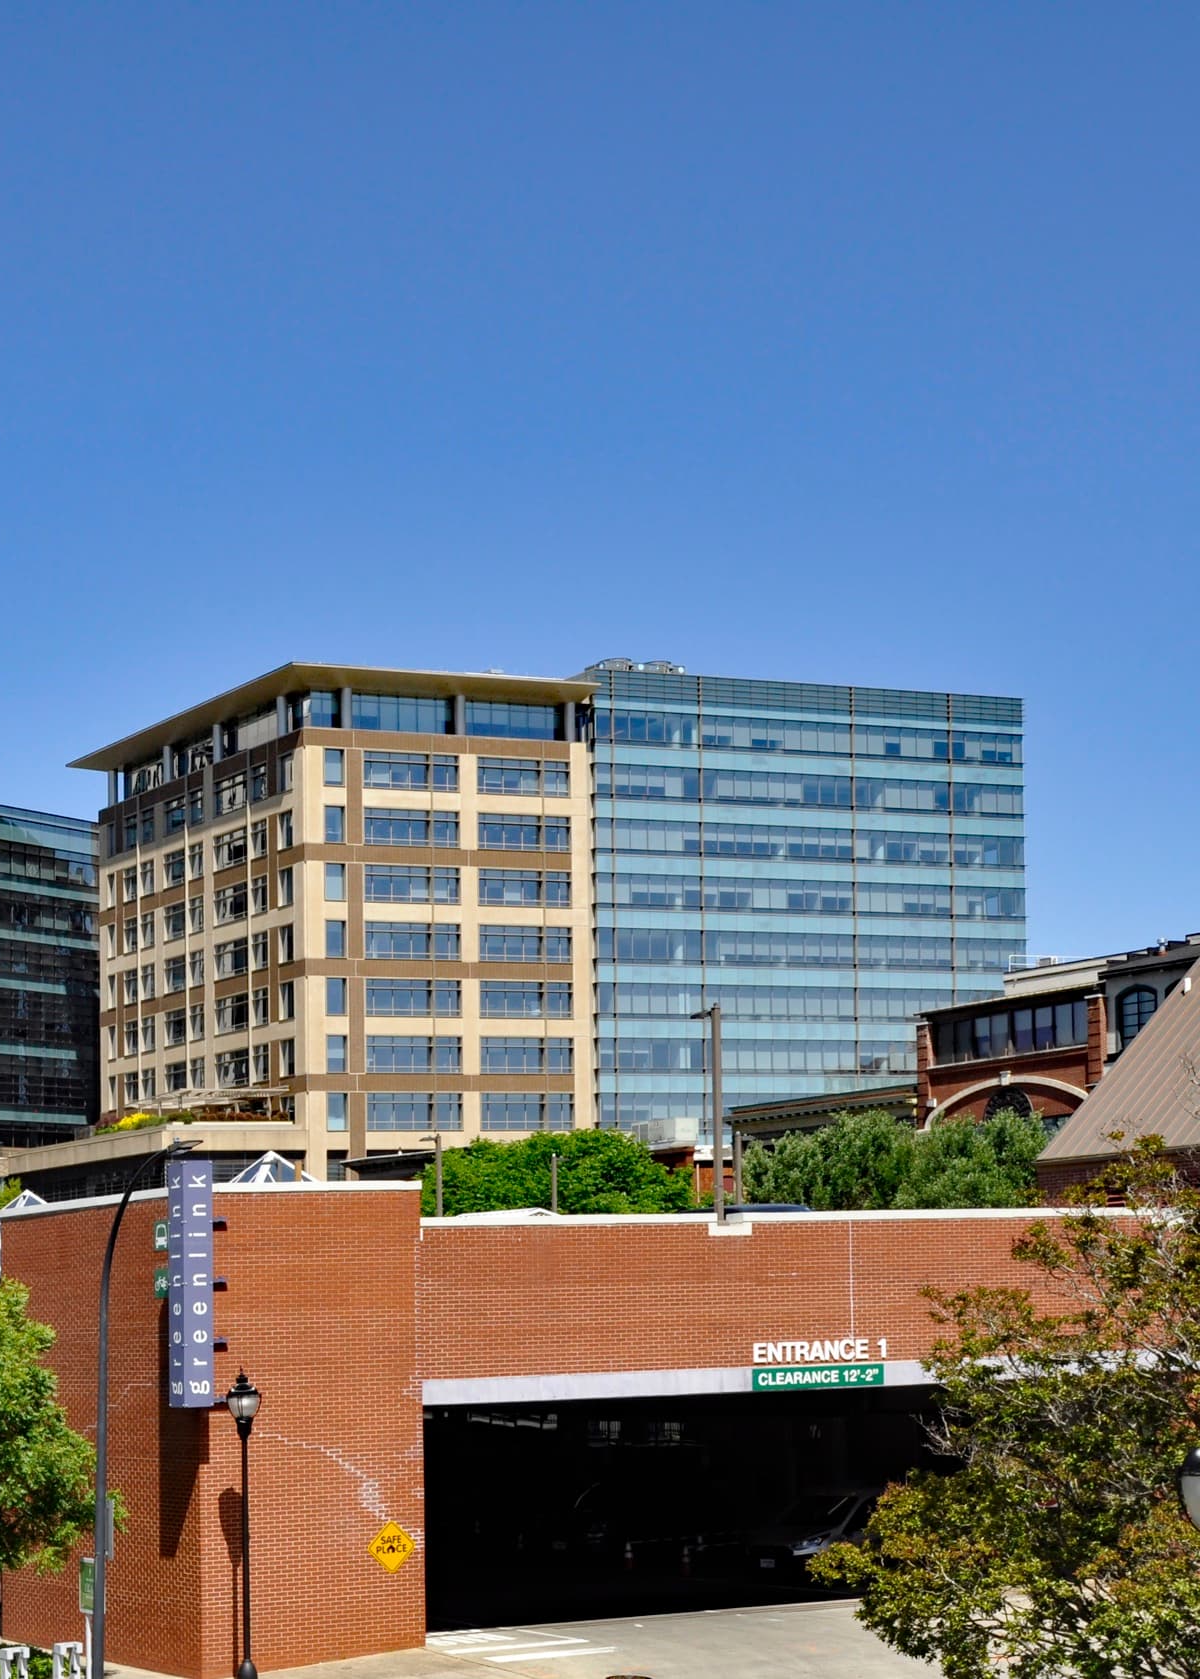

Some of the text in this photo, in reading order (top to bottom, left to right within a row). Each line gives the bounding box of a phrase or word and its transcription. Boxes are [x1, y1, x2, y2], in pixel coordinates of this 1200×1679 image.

[170, 1175, 183, 1395] greenlink
[188, 1174, 210, 1394] greenlink
[753, 1338, 887, 1363] ENTRANCE 1
[758, 1370, 840, 1386] CLEARANCE
[381, 1535, 402, 1544] SAFE
